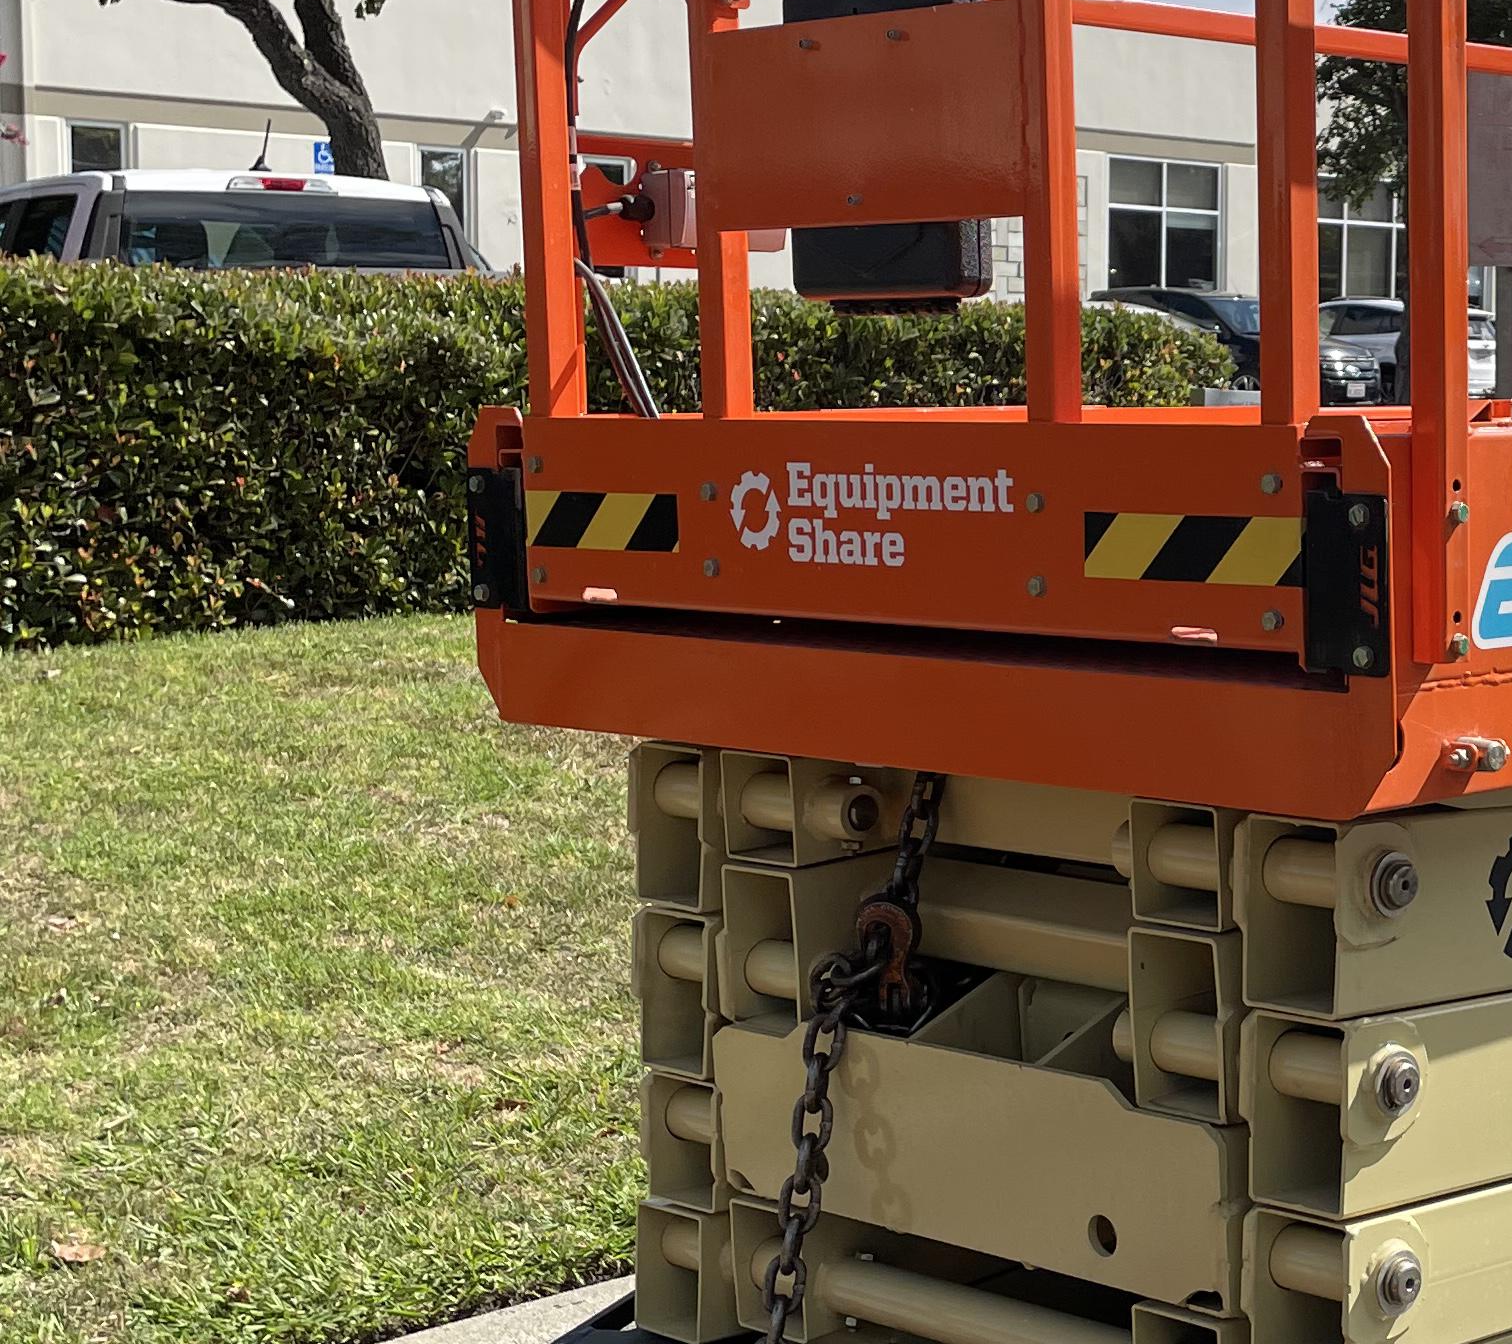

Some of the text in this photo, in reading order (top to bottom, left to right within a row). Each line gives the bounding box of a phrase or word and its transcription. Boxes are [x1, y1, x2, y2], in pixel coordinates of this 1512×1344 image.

[786, 461, 1015, 521] Equipment
[787, 517, 906, 567] Share
[1359, 544, 1380, 630] JLG
